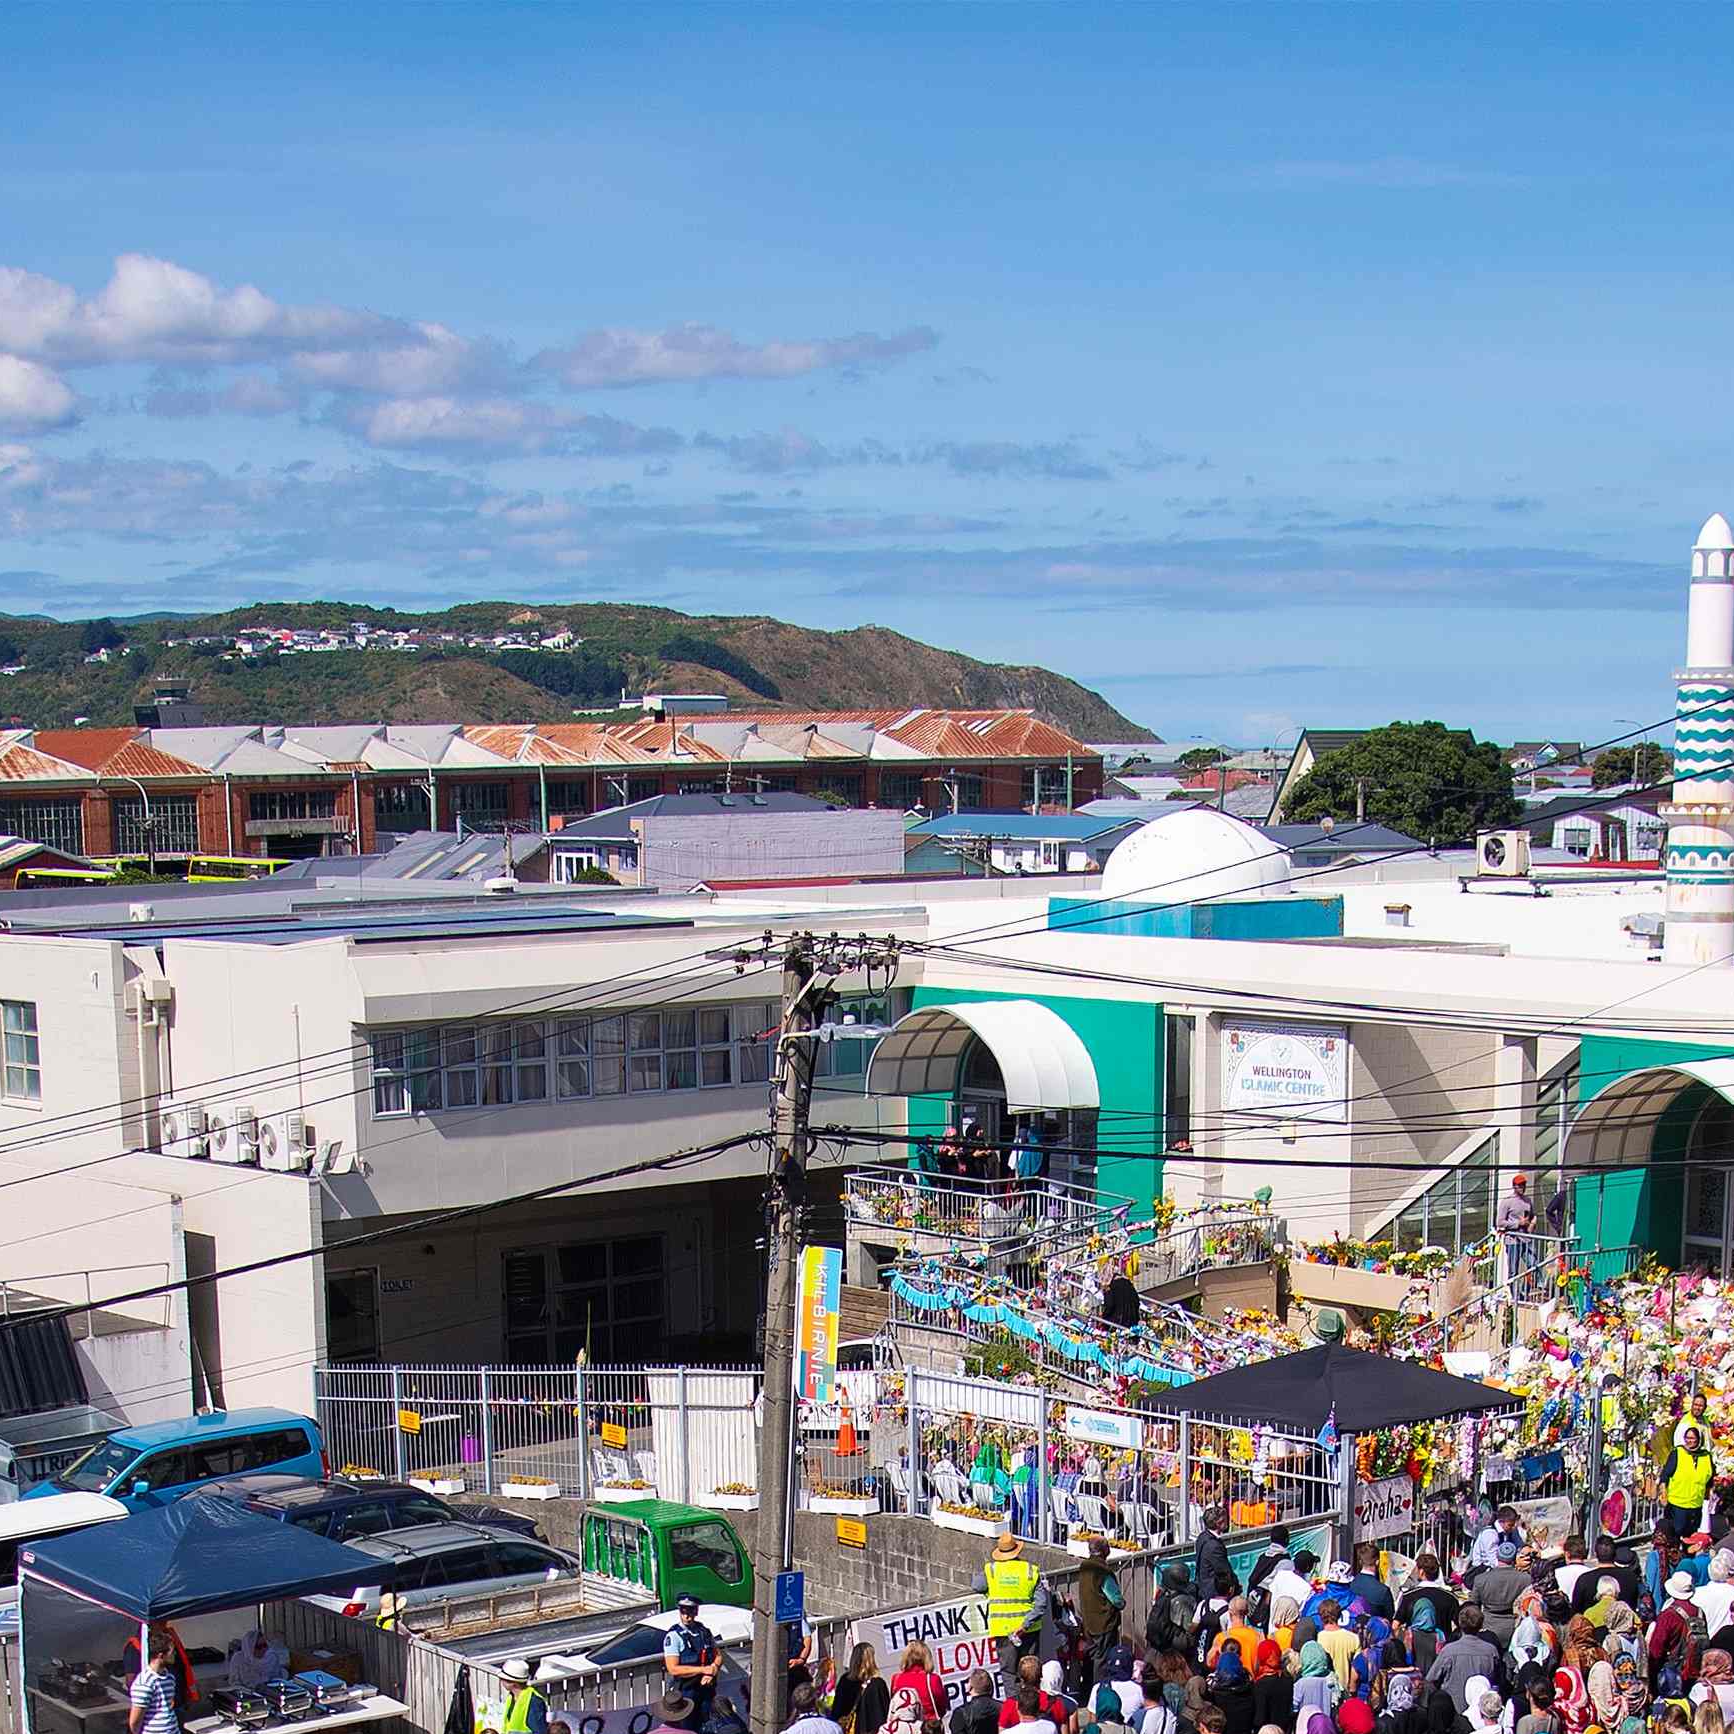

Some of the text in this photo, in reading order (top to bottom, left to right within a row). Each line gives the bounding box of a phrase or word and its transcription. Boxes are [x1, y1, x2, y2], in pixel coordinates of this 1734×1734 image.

[1242, 1079, 1325, 1097] ISLAMIC CENTRE
[1252, 1065, 1311, 1080] WELLINGTON
[808, 1263, 829, 1386] KILBIRNIE
[1361, 1487, 1403, 1526] aroha
[786, 1575, 795, 1588] P
[883, 1605, 971, 1650] THANK
[938, 1636, 1000, 1675] LOVE
